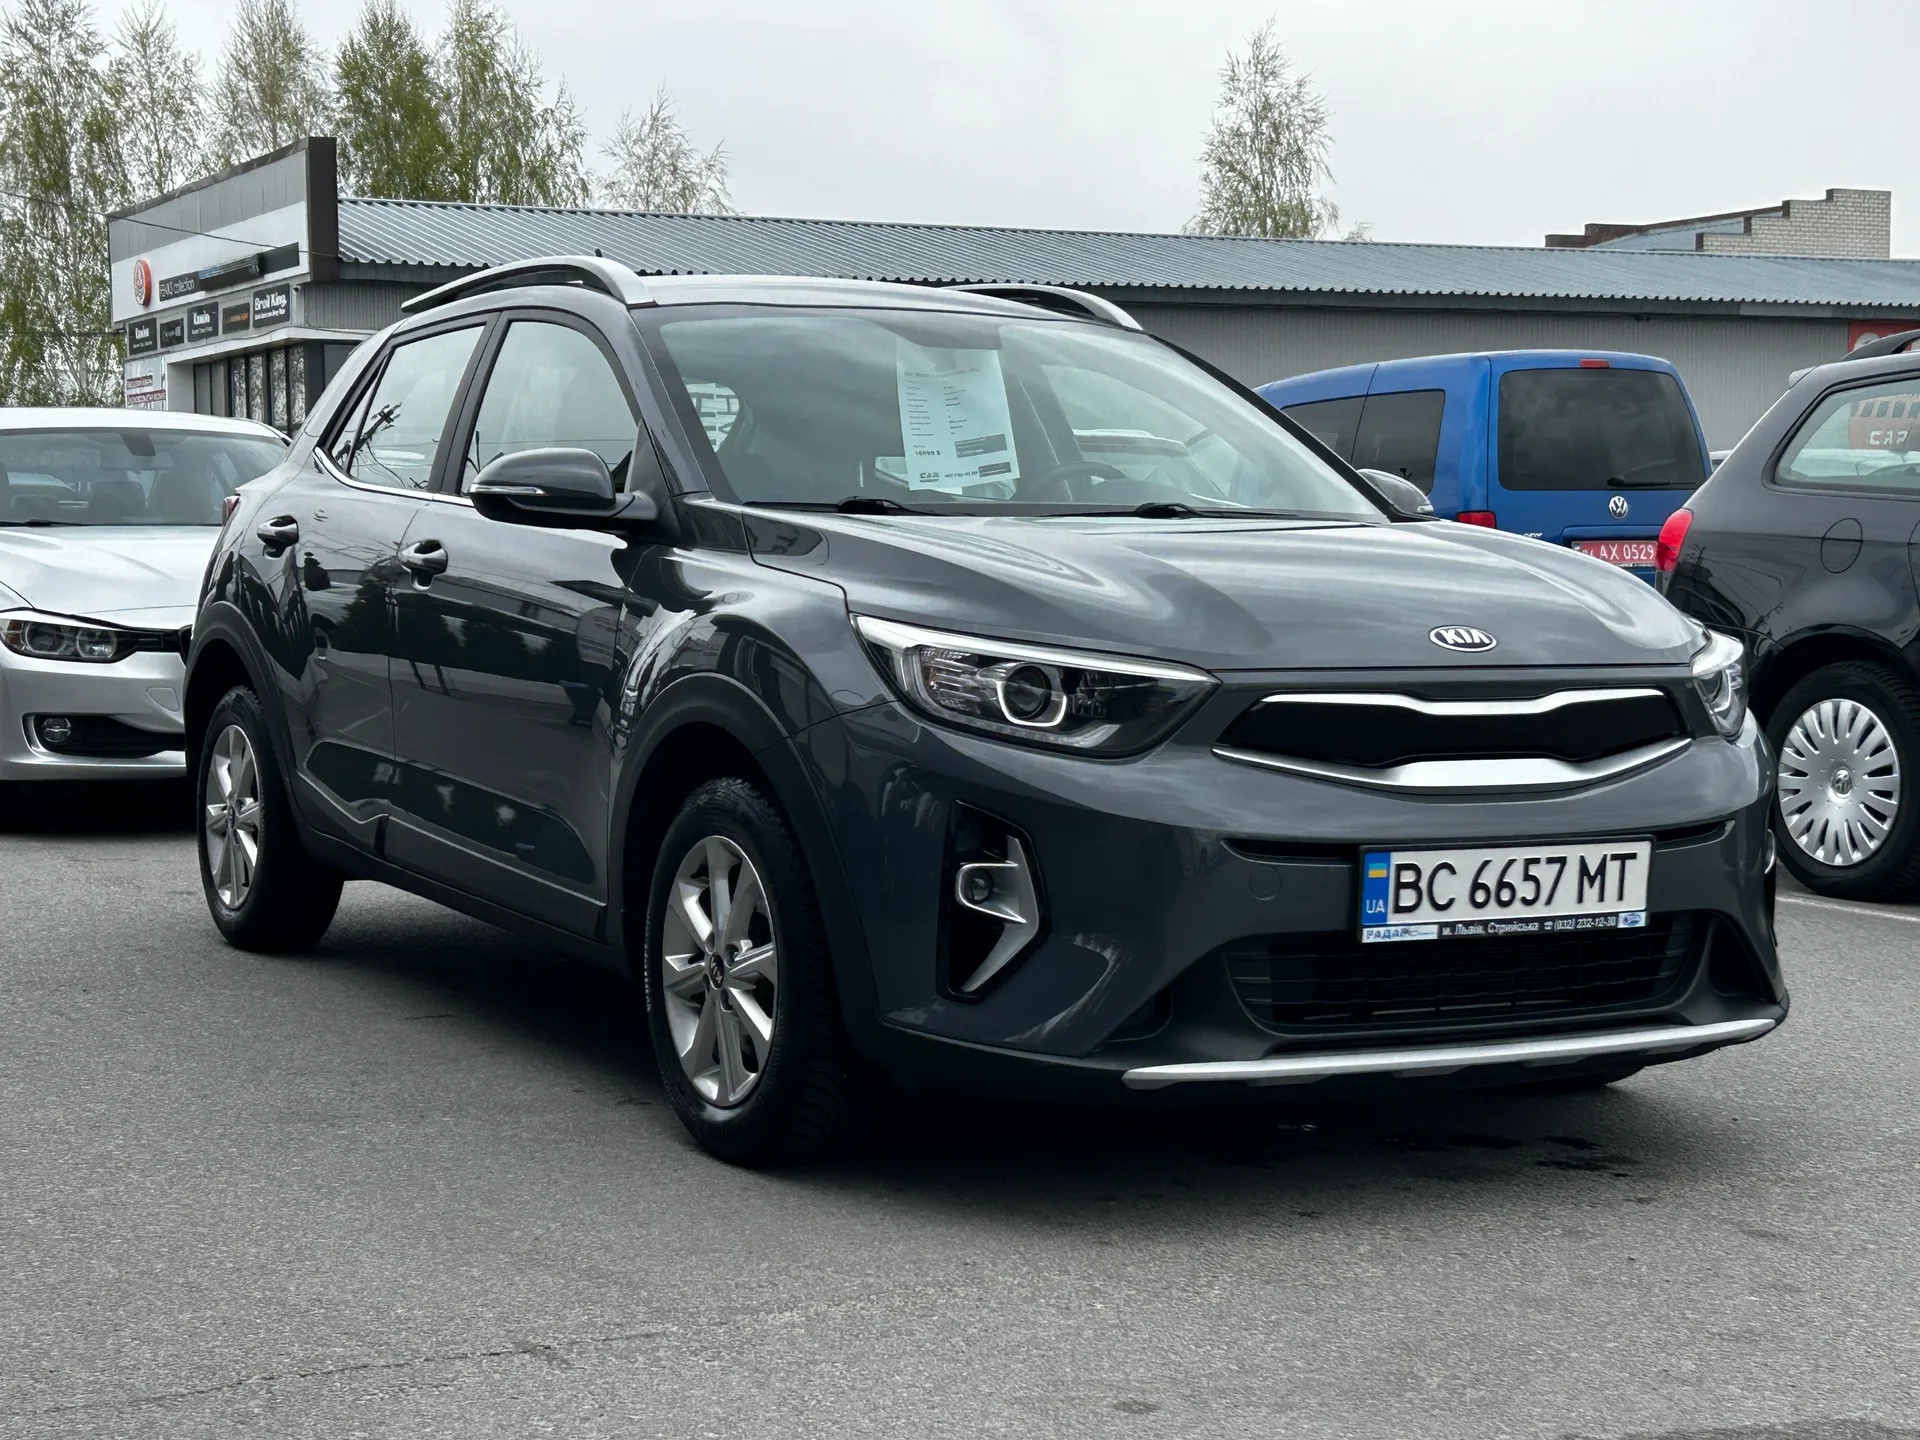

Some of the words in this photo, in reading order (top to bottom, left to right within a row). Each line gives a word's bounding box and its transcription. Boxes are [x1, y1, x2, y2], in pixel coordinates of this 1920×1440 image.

[254, 294, 271, 311] Broil
[1622, 543, 1655, 560] 0529
[1438, 628, 1491, 644] KIA
[1393, 861, 1457, 914] BC
[1469, 855, 1568, 909] 6657
[1577, 852, 1638, 904] MT
[1366, 899, 1385, 914] UA
[1554, 918, 1576, 931] (032)
